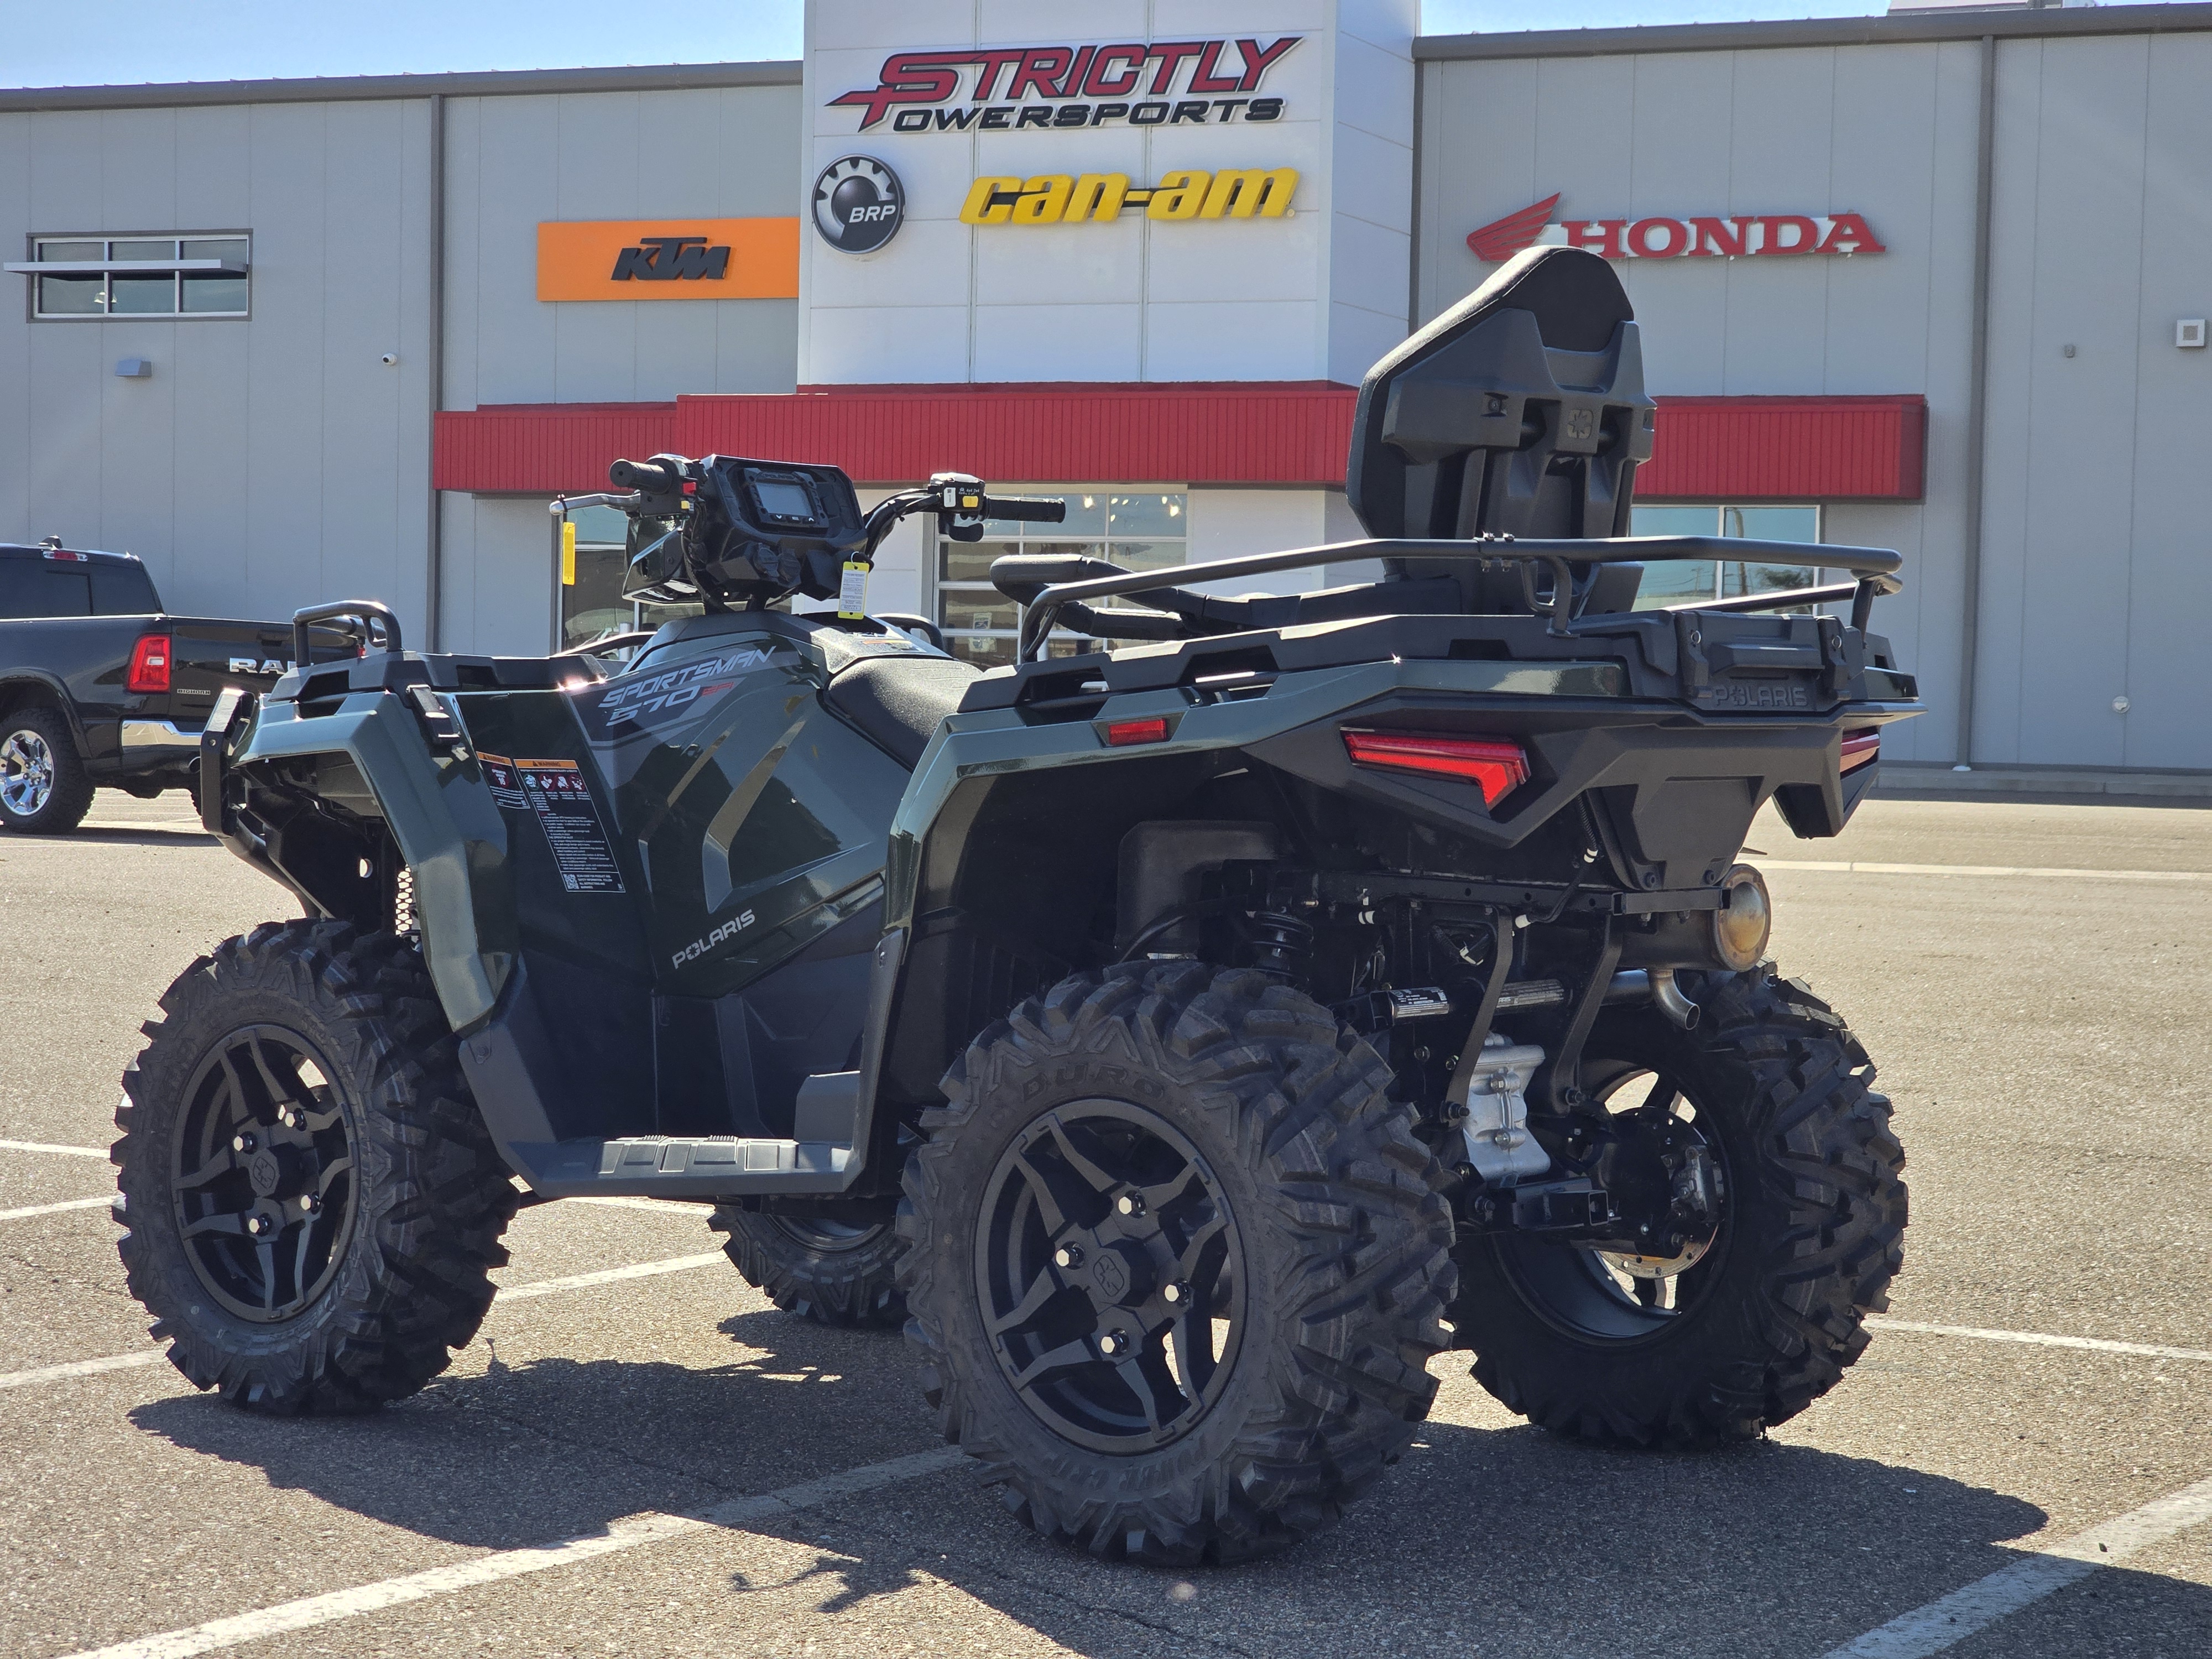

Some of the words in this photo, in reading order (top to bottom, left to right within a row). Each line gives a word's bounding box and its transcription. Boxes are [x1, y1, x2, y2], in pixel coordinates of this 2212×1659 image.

[825, 36, 1303, 111] STRICTLY
[849, 205, 897, 223] BRP
[958, 167, 1300, 225] can-am
[1561, 213, 1886, 258] HONDA
[611, 237, 732, 280] KTM
[229, 657, 297, 675] RA
[598, 645, 777, 707] SPORTSMAN
[606, 685, 701, 726] 570
[1711, 685, 1808, 707] POLARIS
[672, 909, 756, 969] POLARIS
[1022, 1062, 1164, 1103] DURO
